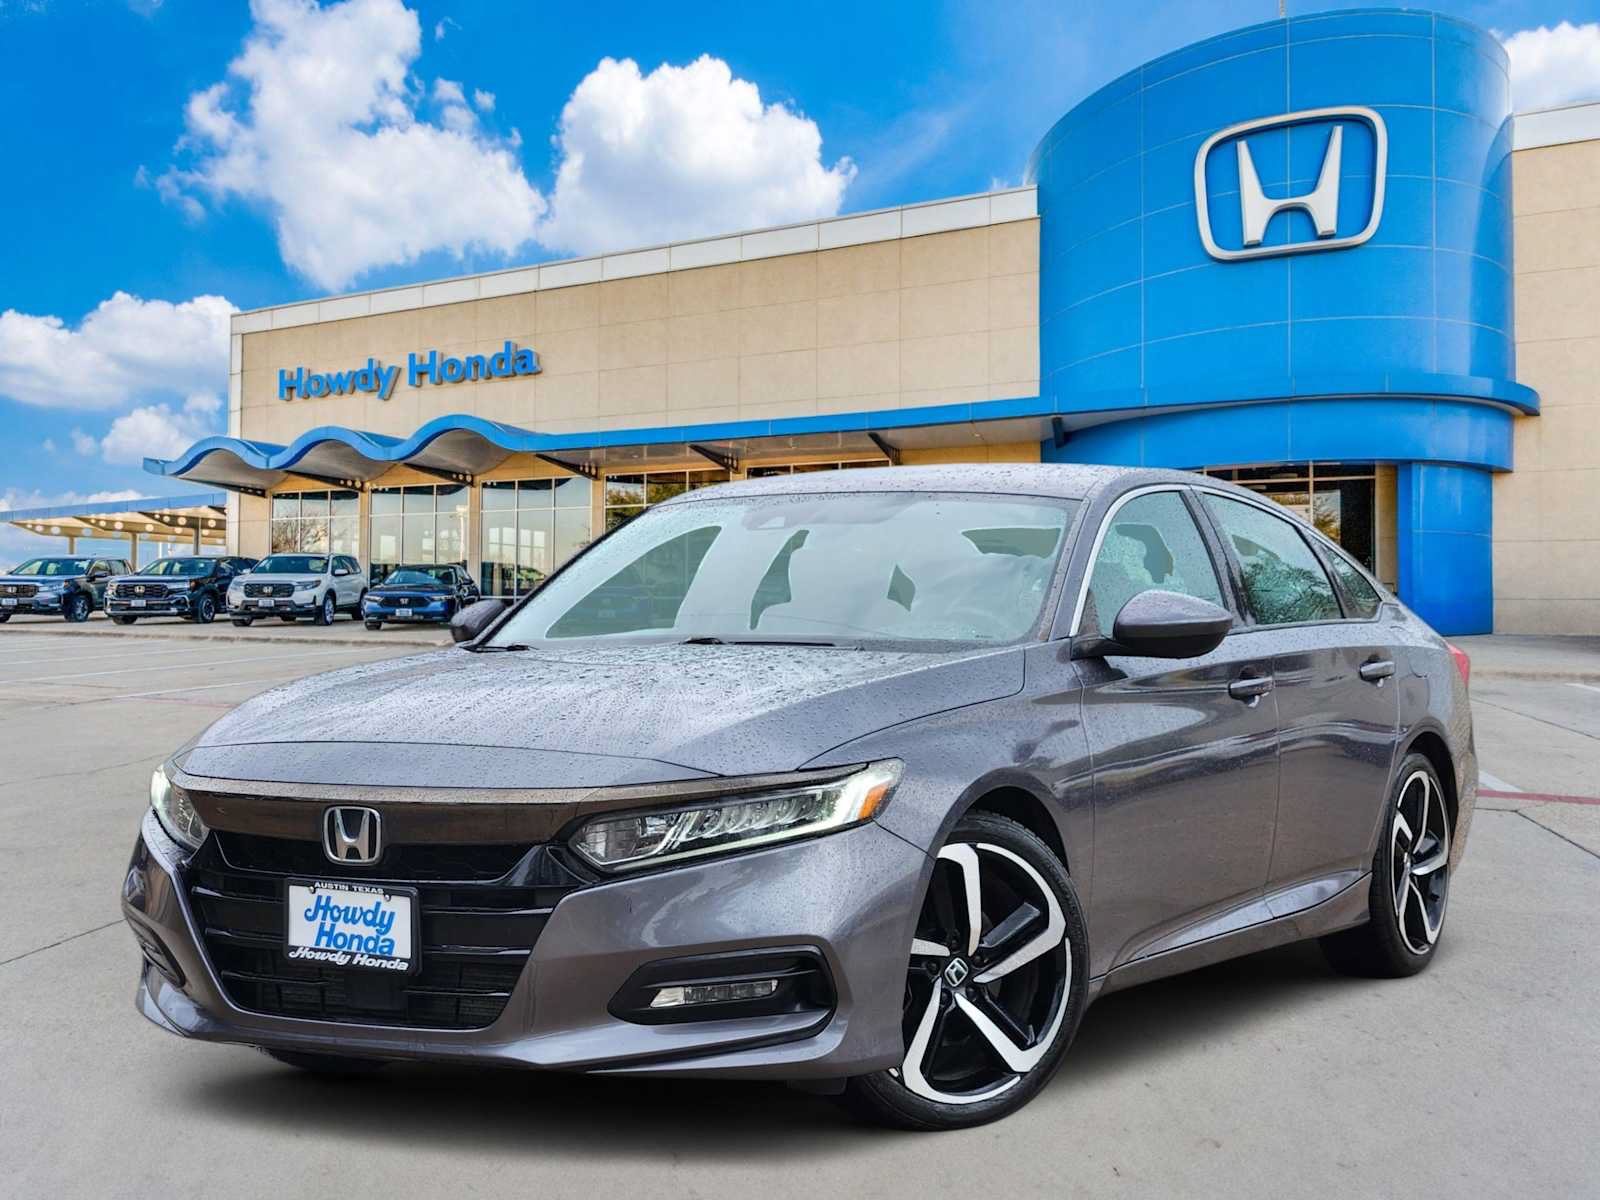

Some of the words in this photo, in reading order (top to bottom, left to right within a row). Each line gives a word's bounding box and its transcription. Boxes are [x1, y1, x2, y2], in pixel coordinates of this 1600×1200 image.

[278, 358, 401, 401] Howdy
[407, 340, 541, 387] Honda
[314, 881, 349, 891] AUSTIN
[351, 885, 384, 894] TEXAS
[304, 895, 396, 936] Howdy
[314, 922, 396, 957] Honda
[288, 946, 352, 966] Howdy
[352, 953, 409, 971] Honda
